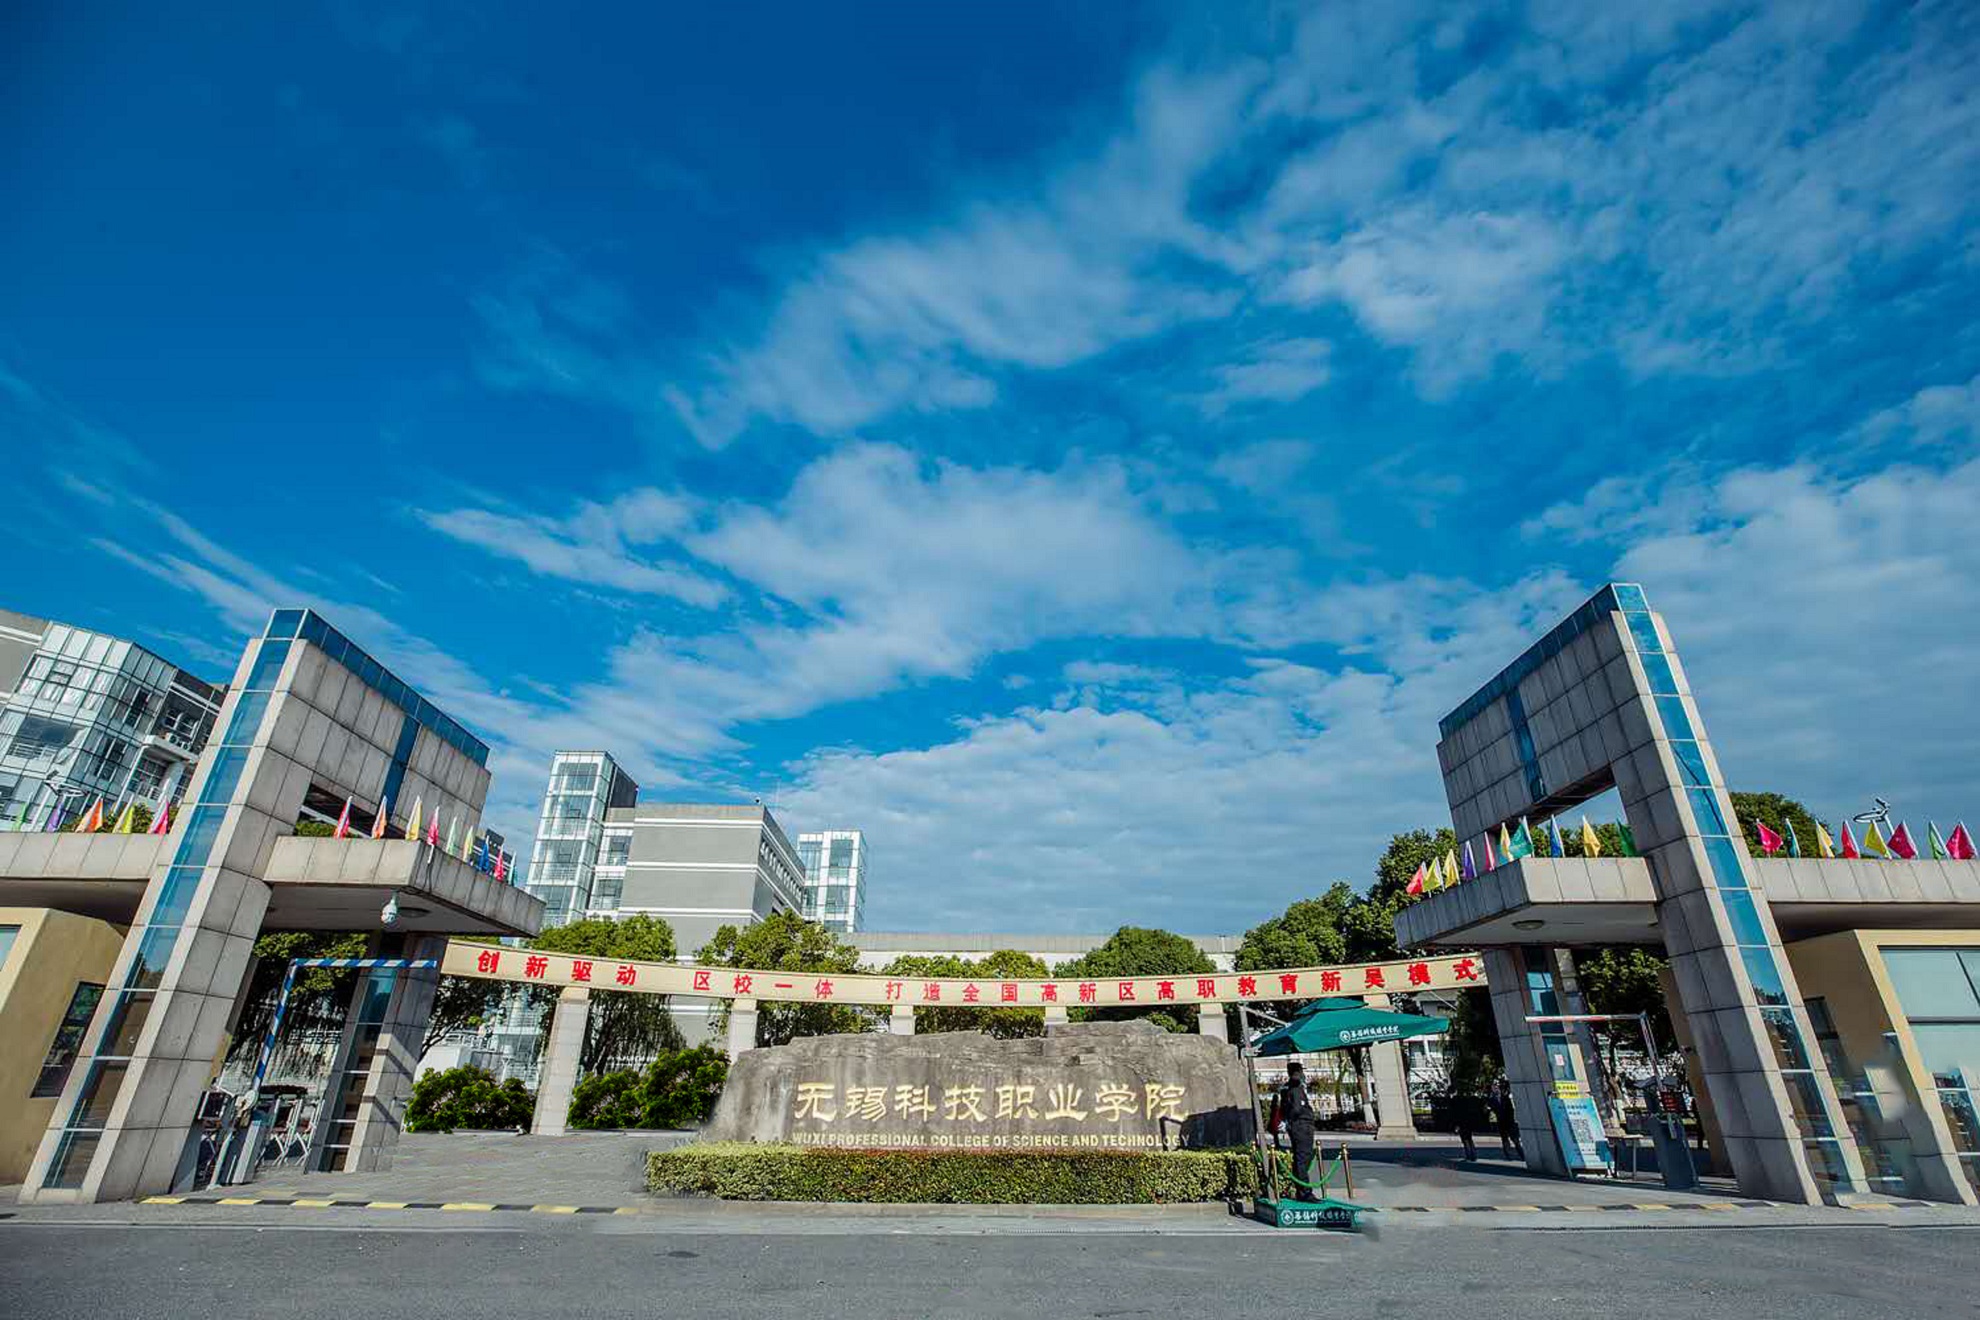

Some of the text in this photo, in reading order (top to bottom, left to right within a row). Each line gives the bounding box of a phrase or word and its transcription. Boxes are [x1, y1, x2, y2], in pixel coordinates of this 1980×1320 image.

[476, 949, 1479, 1002] 创新驱动 区校一体 打造全国高新区高职教育新吴模式
[794, 1082, 1189, 1122] 无锡科技职业学院
[793, 1132, 1190, 1147] WUXI PROFESSIONAL COLLEGE OF SCIENCE AND TECHNOLOGY
